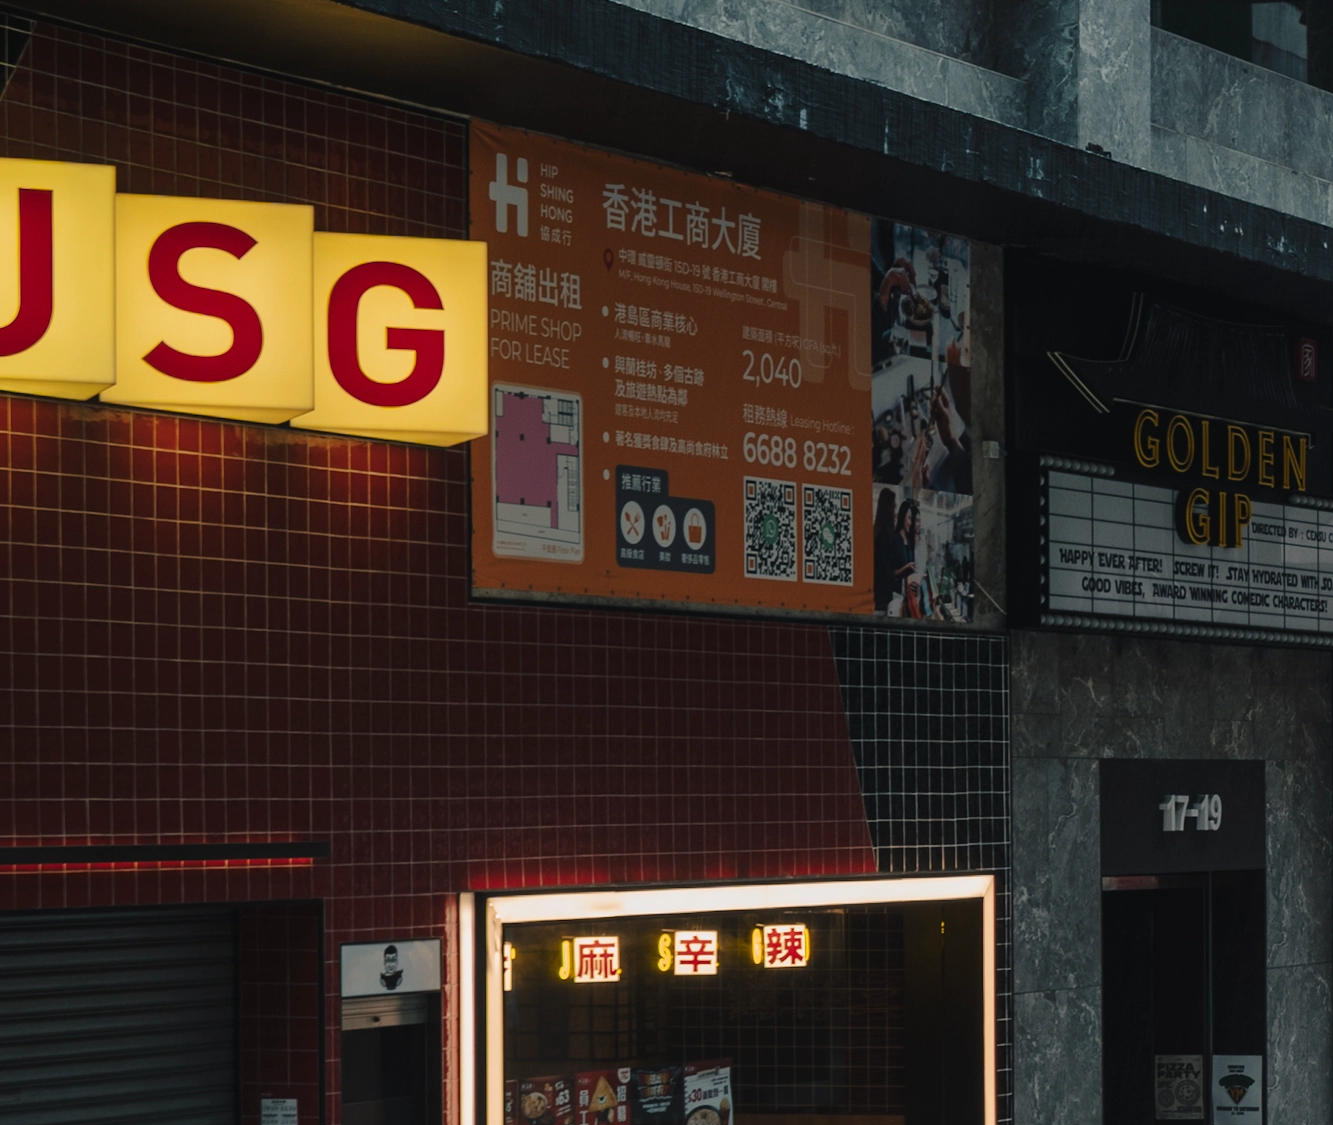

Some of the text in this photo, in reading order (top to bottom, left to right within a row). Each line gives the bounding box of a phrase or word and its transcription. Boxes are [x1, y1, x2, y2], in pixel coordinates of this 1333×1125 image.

[540, 163, 559, 179] HIP
[540, 183, 574, 204] SHING
[540, 204, 573, 224] HONG
[602, 183, 762, 261] 香港工商大廈
[540, 225, 572, 246] 協成行
[490, 259, 582, 310] 商舖出租
[490, 308, 582, 342] PRIME SHOP
[614, 302, 699, 336] 港島區商業核心
[490, 337, 570, 370] FOR LEASE
[742, 349, 802, 389] 2,040
[743, 431, 852, 476] 6688 8232
[1132, 406, 1307, 491] GOLDEN
[1185, 487, 1252, 549] GIP
[1252, 520, 1285, 538] DIRECTED
[1287, 527, 1298, 539] BY
[1059, 548, 1094, 566] HAPPY
[1098, 552, 1125, 569] EVER
[1128, 556, 1162, 573] AFTER!
[1173, 561, 1205, 578] SCREW
[1207, 565, 1219, 579] IT!
[1226, 567, 1249, 581] STAY
[1252, 569, 1298, 588] HYDRATED
[1300, 575, 1320, 590] WITH
[1082, 576, 1327, 613] GOOD VIBES, AWARD WINNING COMEDIC CHARACTERS!
[1159, 793, 1222, 832] 17-19
[578, 928, 803, 979] 麻 辛 辣
[1157, 1062, 1195, 1071] PIZZA
[1157, 1071, 1200, 1079] PARTY
